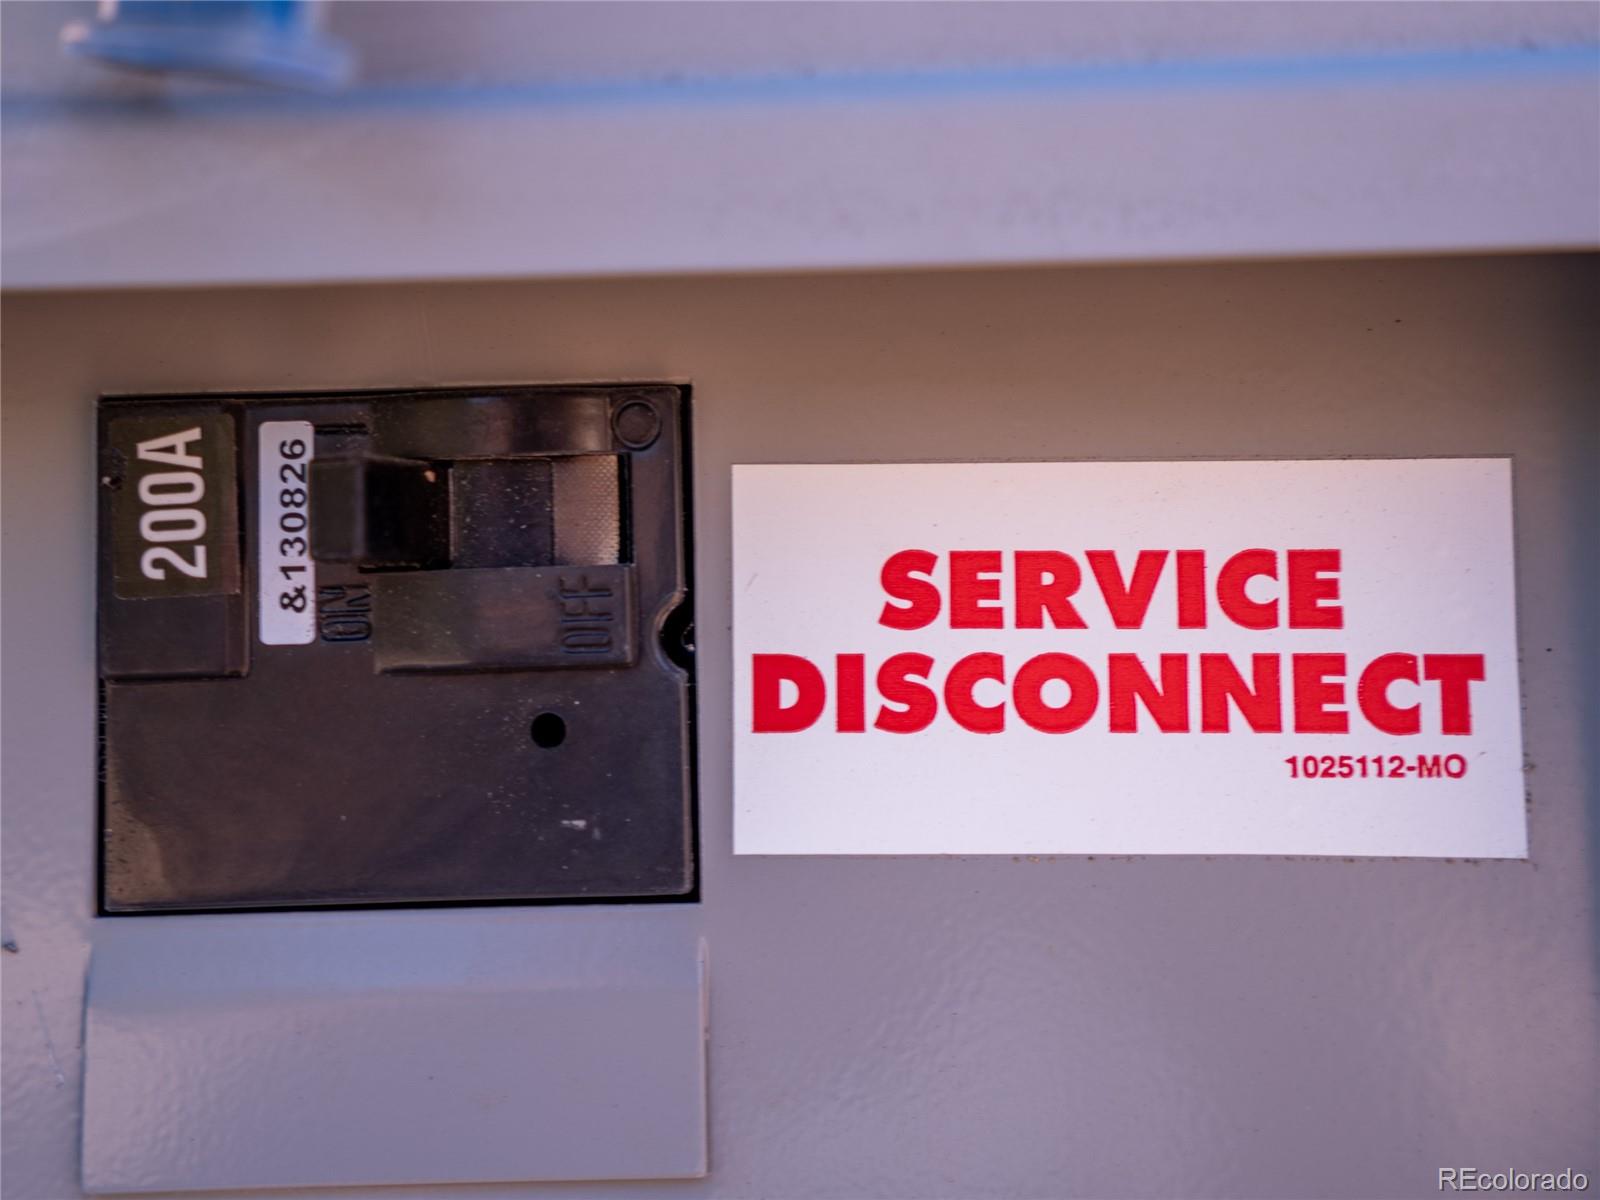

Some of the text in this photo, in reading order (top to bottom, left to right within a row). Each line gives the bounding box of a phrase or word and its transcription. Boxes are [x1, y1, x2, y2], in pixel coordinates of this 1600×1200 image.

[136, 427, 208, 581] 200A
[278, 438, 309, 614] &130826
[320, 583, 371, 643] ON
[559, 574, 613, 654] OFF
[878, 548, 1344, 631] SERVICE
[752, 652, 1486, 736] DISCONNECT
[1285, 753, 1467, 779] 1025112-MO
